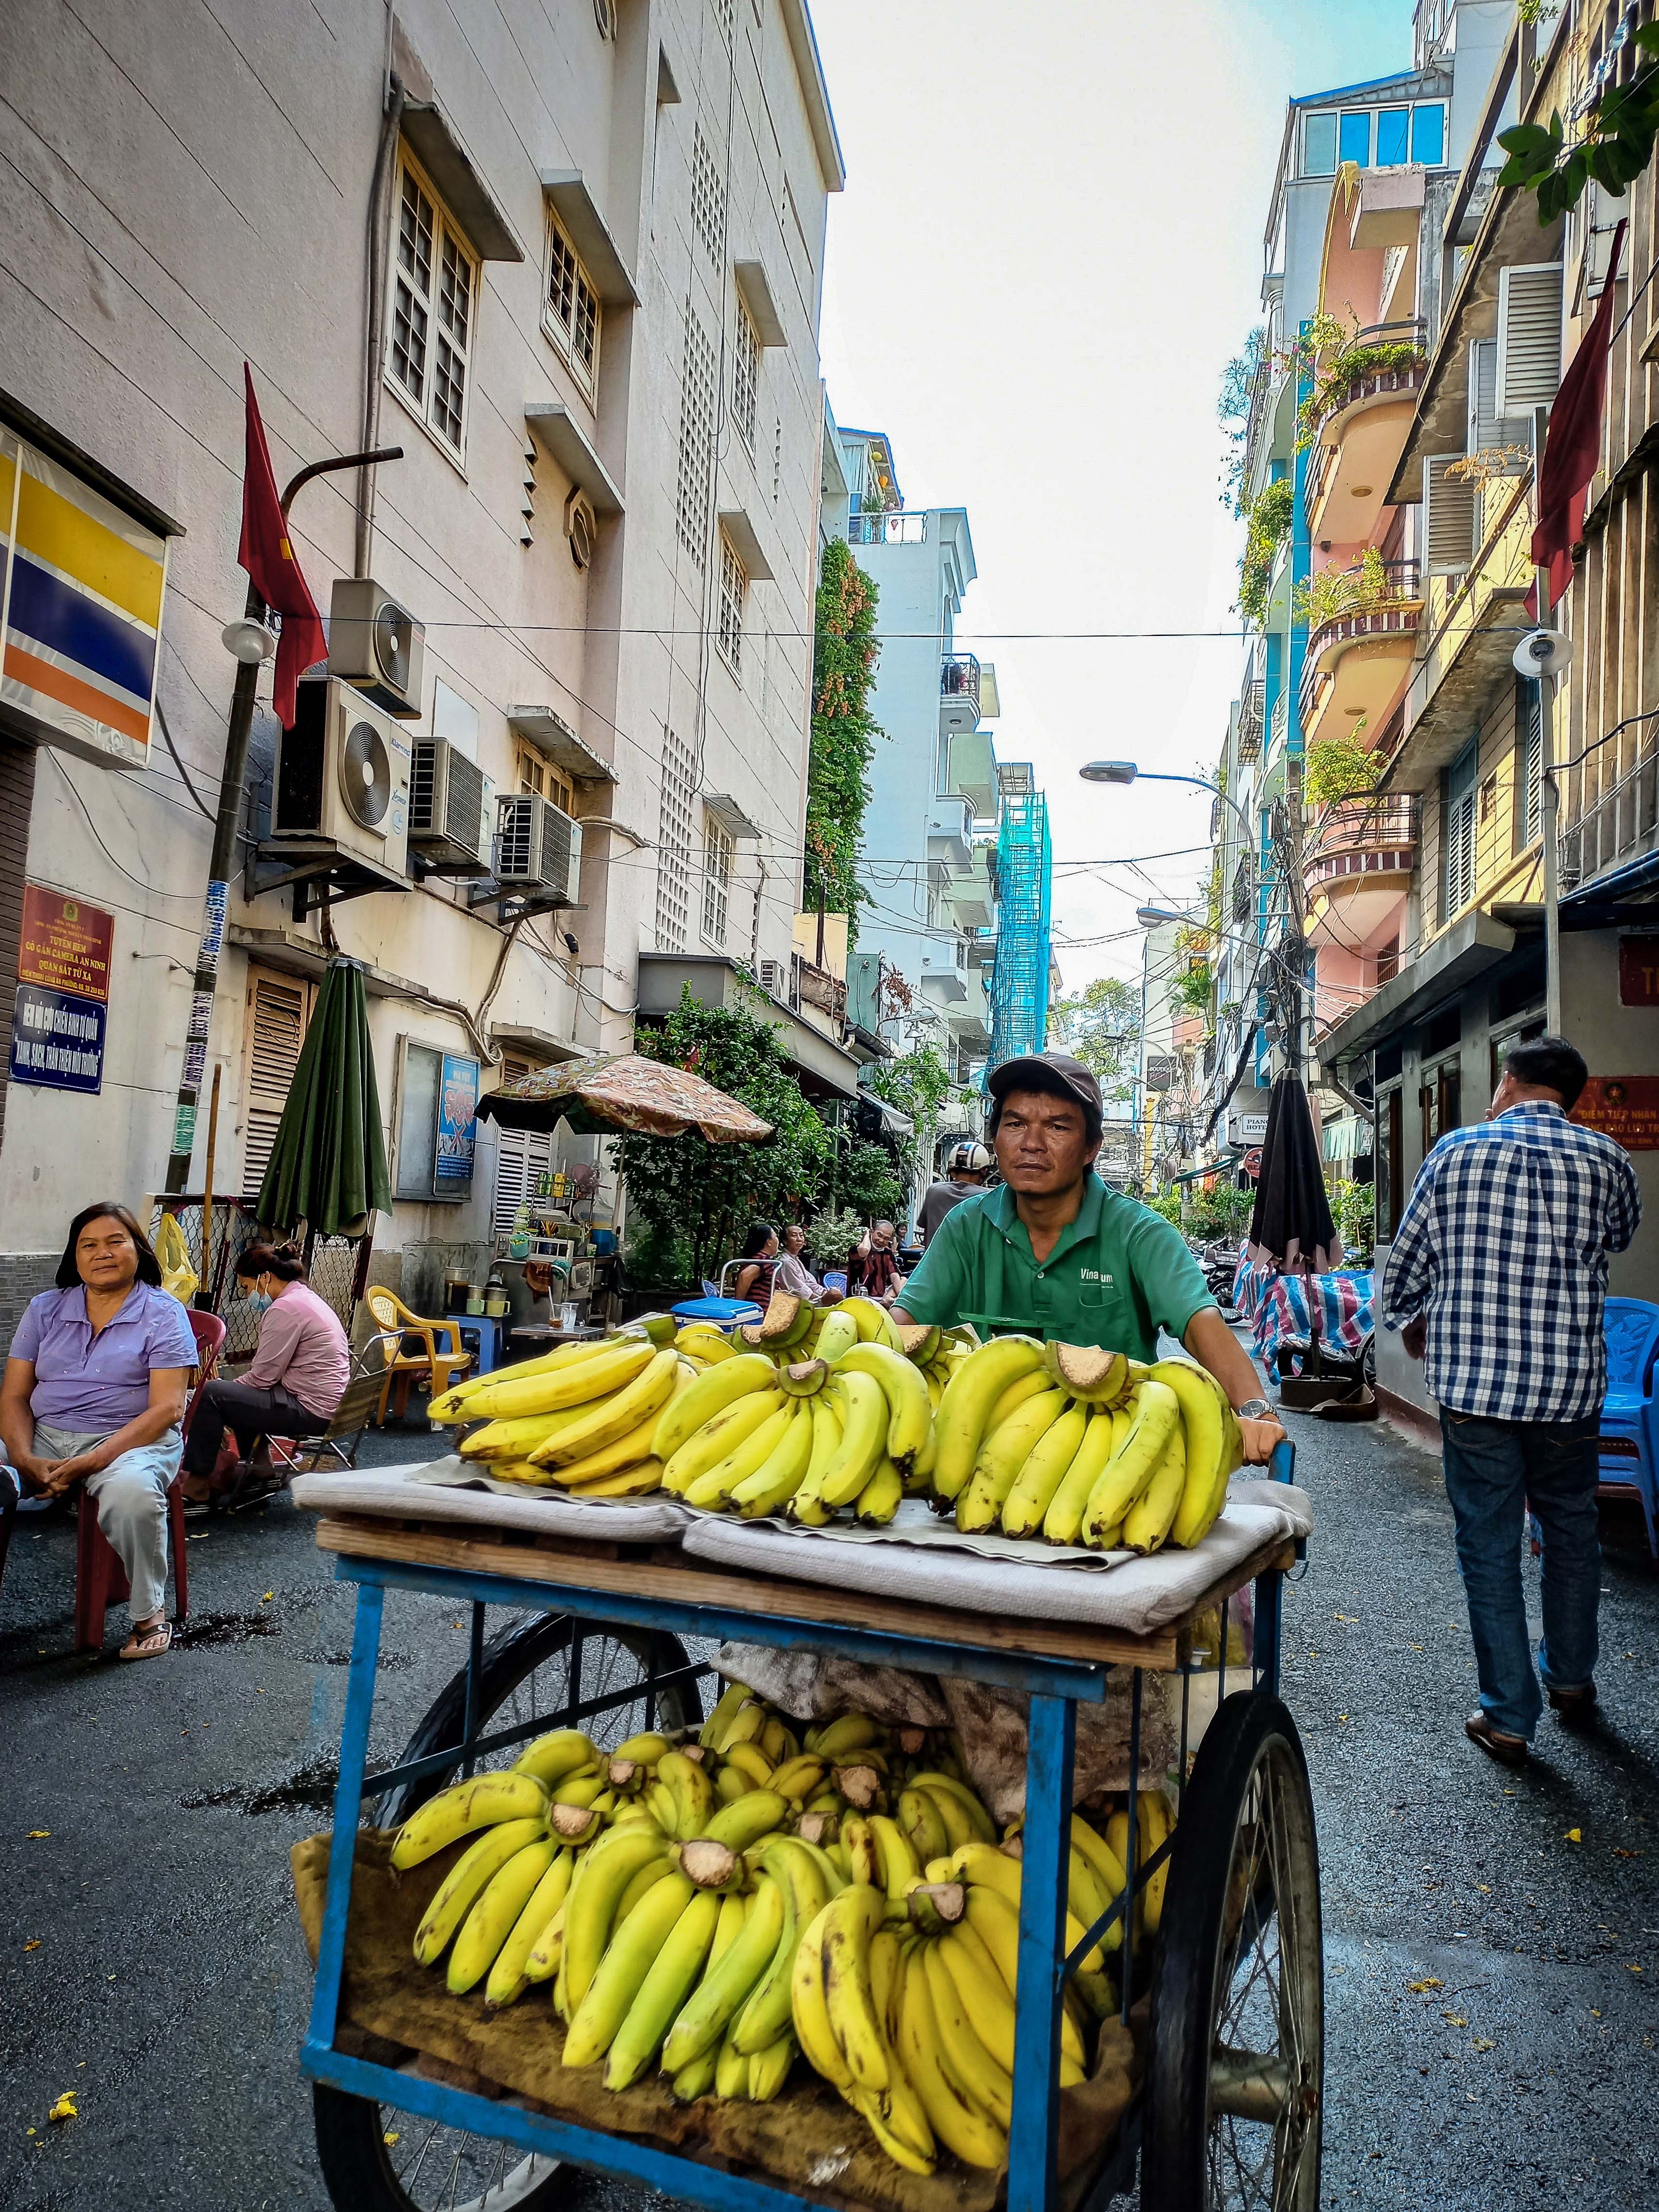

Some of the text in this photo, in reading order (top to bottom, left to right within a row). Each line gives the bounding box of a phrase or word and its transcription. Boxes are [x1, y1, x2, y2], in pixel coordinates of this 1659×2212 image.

[52, 948, 78, 963] CAMERA
[79, 956, 89, 966] AN
[90, 959, 106, 971] NINH
[38, 959, 91, 981] QUAN SÁT TỪ XA
[189, 1019, 208, 1036] 0933
[1648, 1123, 1659, 1133] TR
